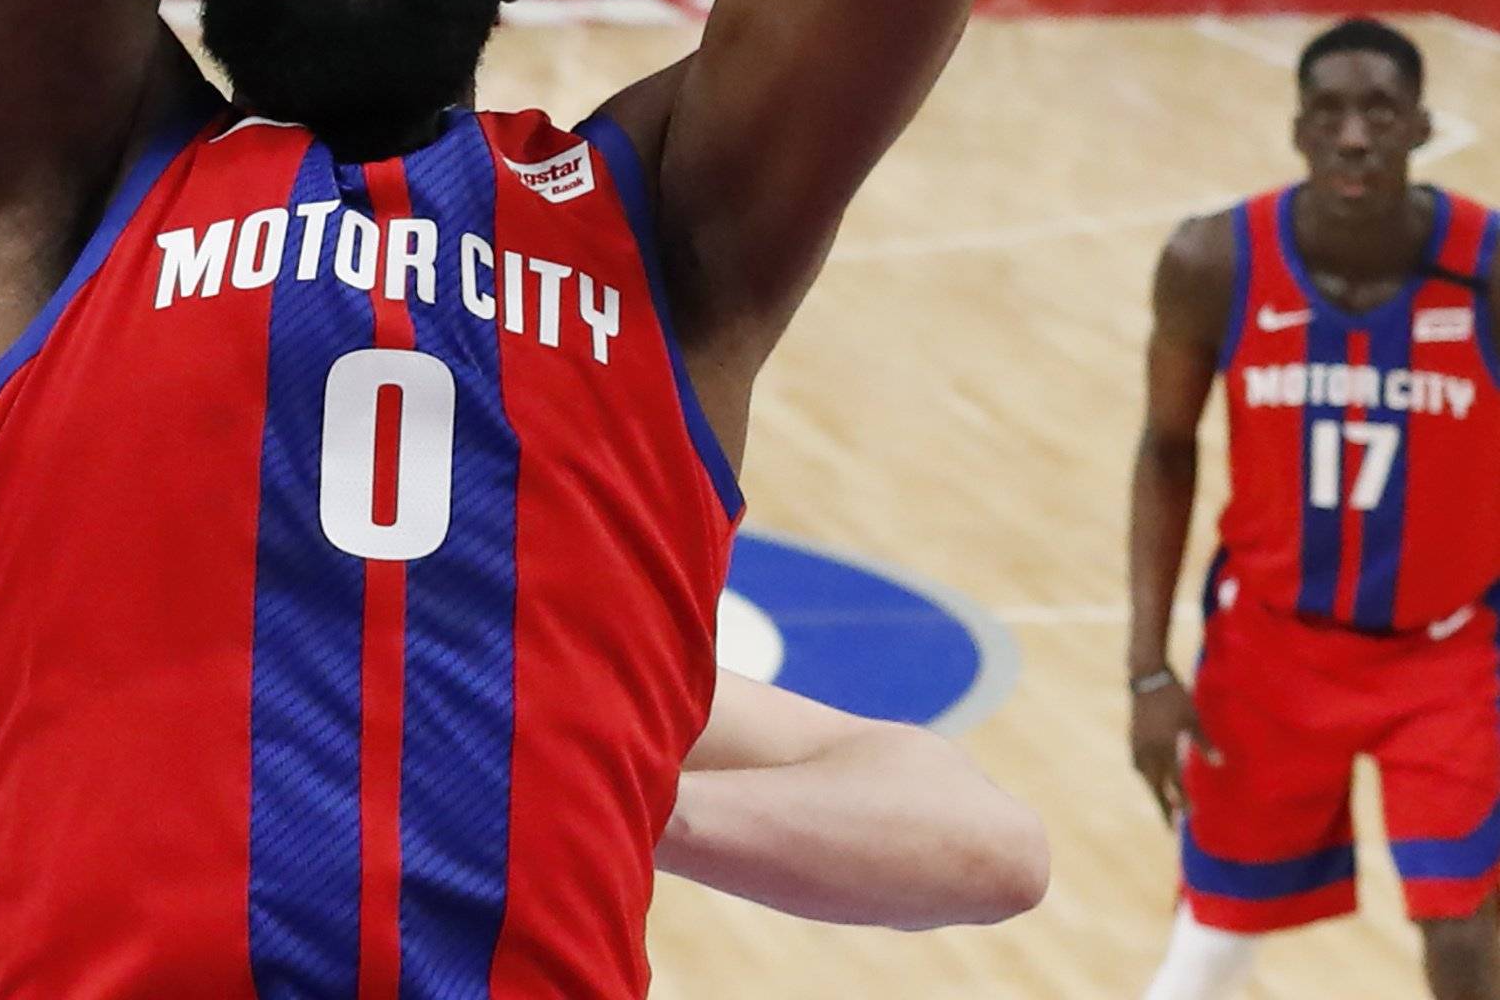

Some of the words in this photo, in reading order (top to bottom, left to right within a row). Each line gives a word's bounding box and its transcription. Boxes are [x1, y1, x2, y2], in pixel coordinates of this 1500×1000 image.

[517, 156, 582, 187] gstar
[552, 177, 584, 195] Bank
[154, 198, 438, 311] MOTOR
[461, 232, 621, 366] CITY
[1243, 363, 1381, 409] MOTOR
[1384, 367, 1477, 420] CITY
[320, 348, 456, 561] 0
[1310, 418, 1400, 511] 17
